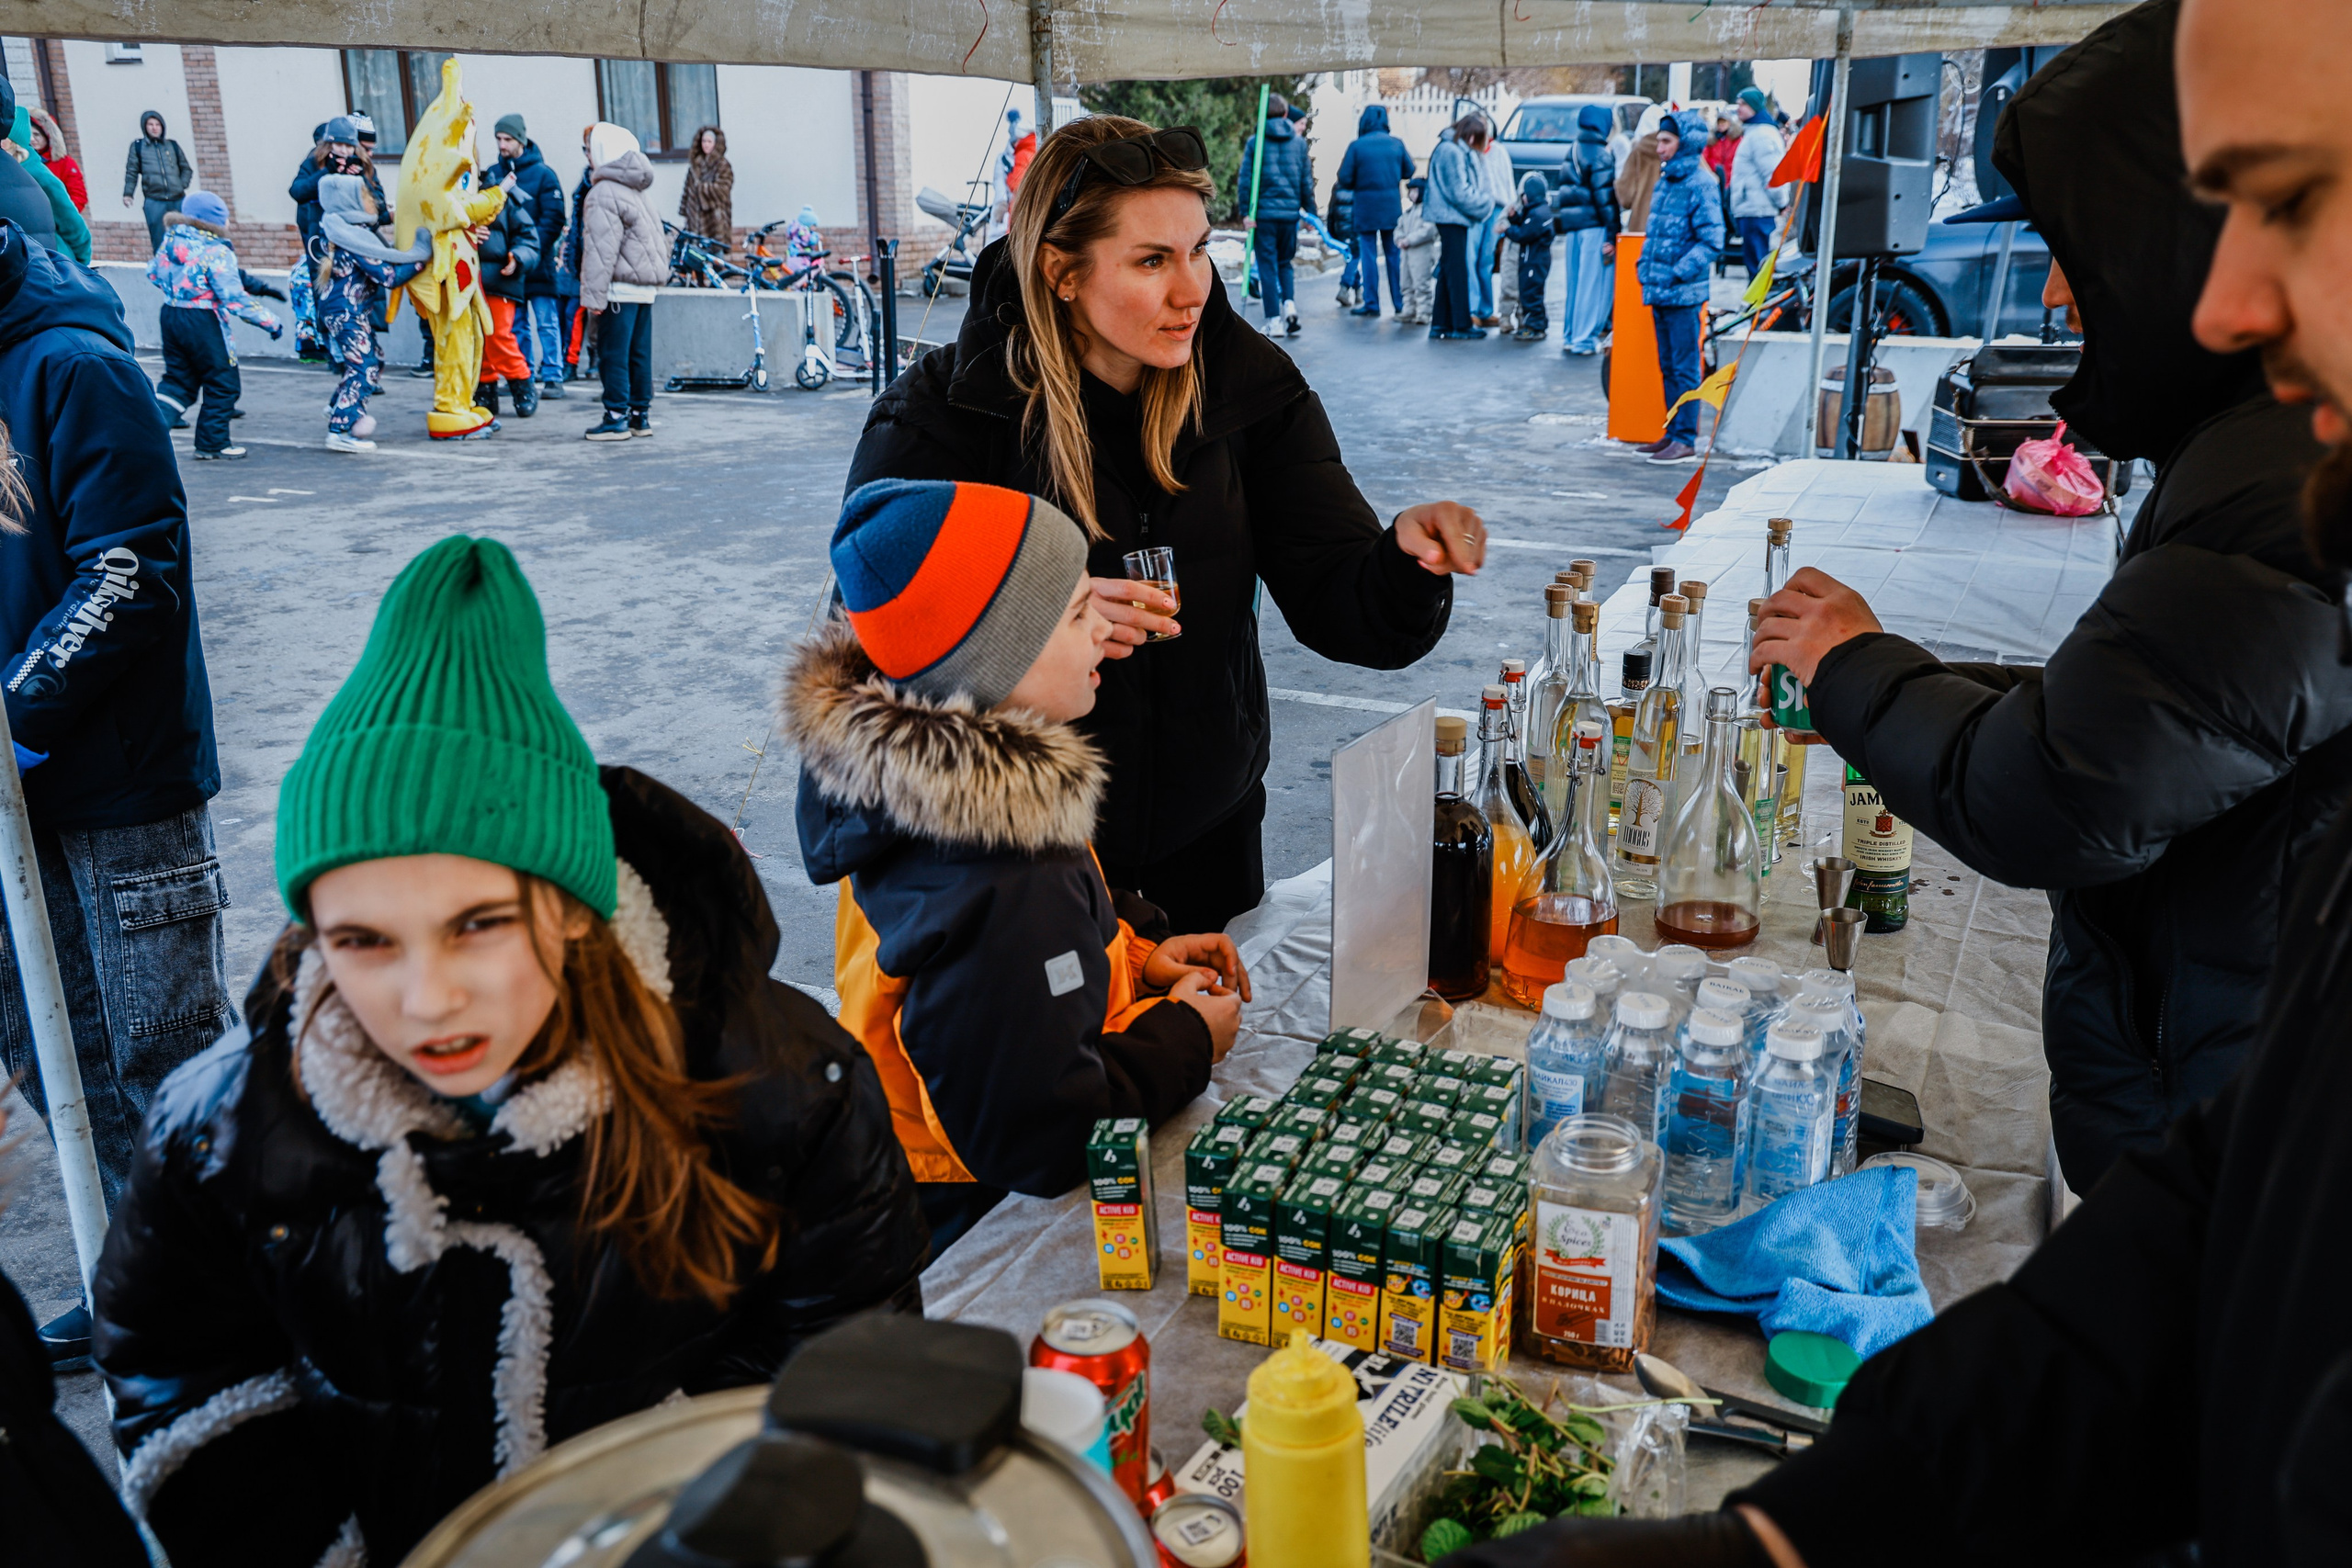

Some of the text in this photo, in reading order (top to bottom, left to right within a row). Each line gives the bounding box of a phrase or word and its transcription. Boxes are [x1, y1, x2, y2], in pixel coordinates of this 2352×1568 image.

[1857, 838, 1878, 846] TRIPLE
[1099, 1204, 1136, 1214] ACTIVE KID
[1192, 1212, 1214, 1224] ACTIVE
[1226, 1251, 1263, 1267] ACTIVE KID
[1279, 1263, 1317, 1280] ACTIVE KID
[1332, 1278, 1358, 1292] ACTIVE
[1358, 1283, 1371, 1293] KID
[1550, 1284, 1596, 1303] КОРИЦА
[1549, 1298, 1605, 1314] ПАЛОЧКАХ
[1217, 1469, 1245, 1497] 100
